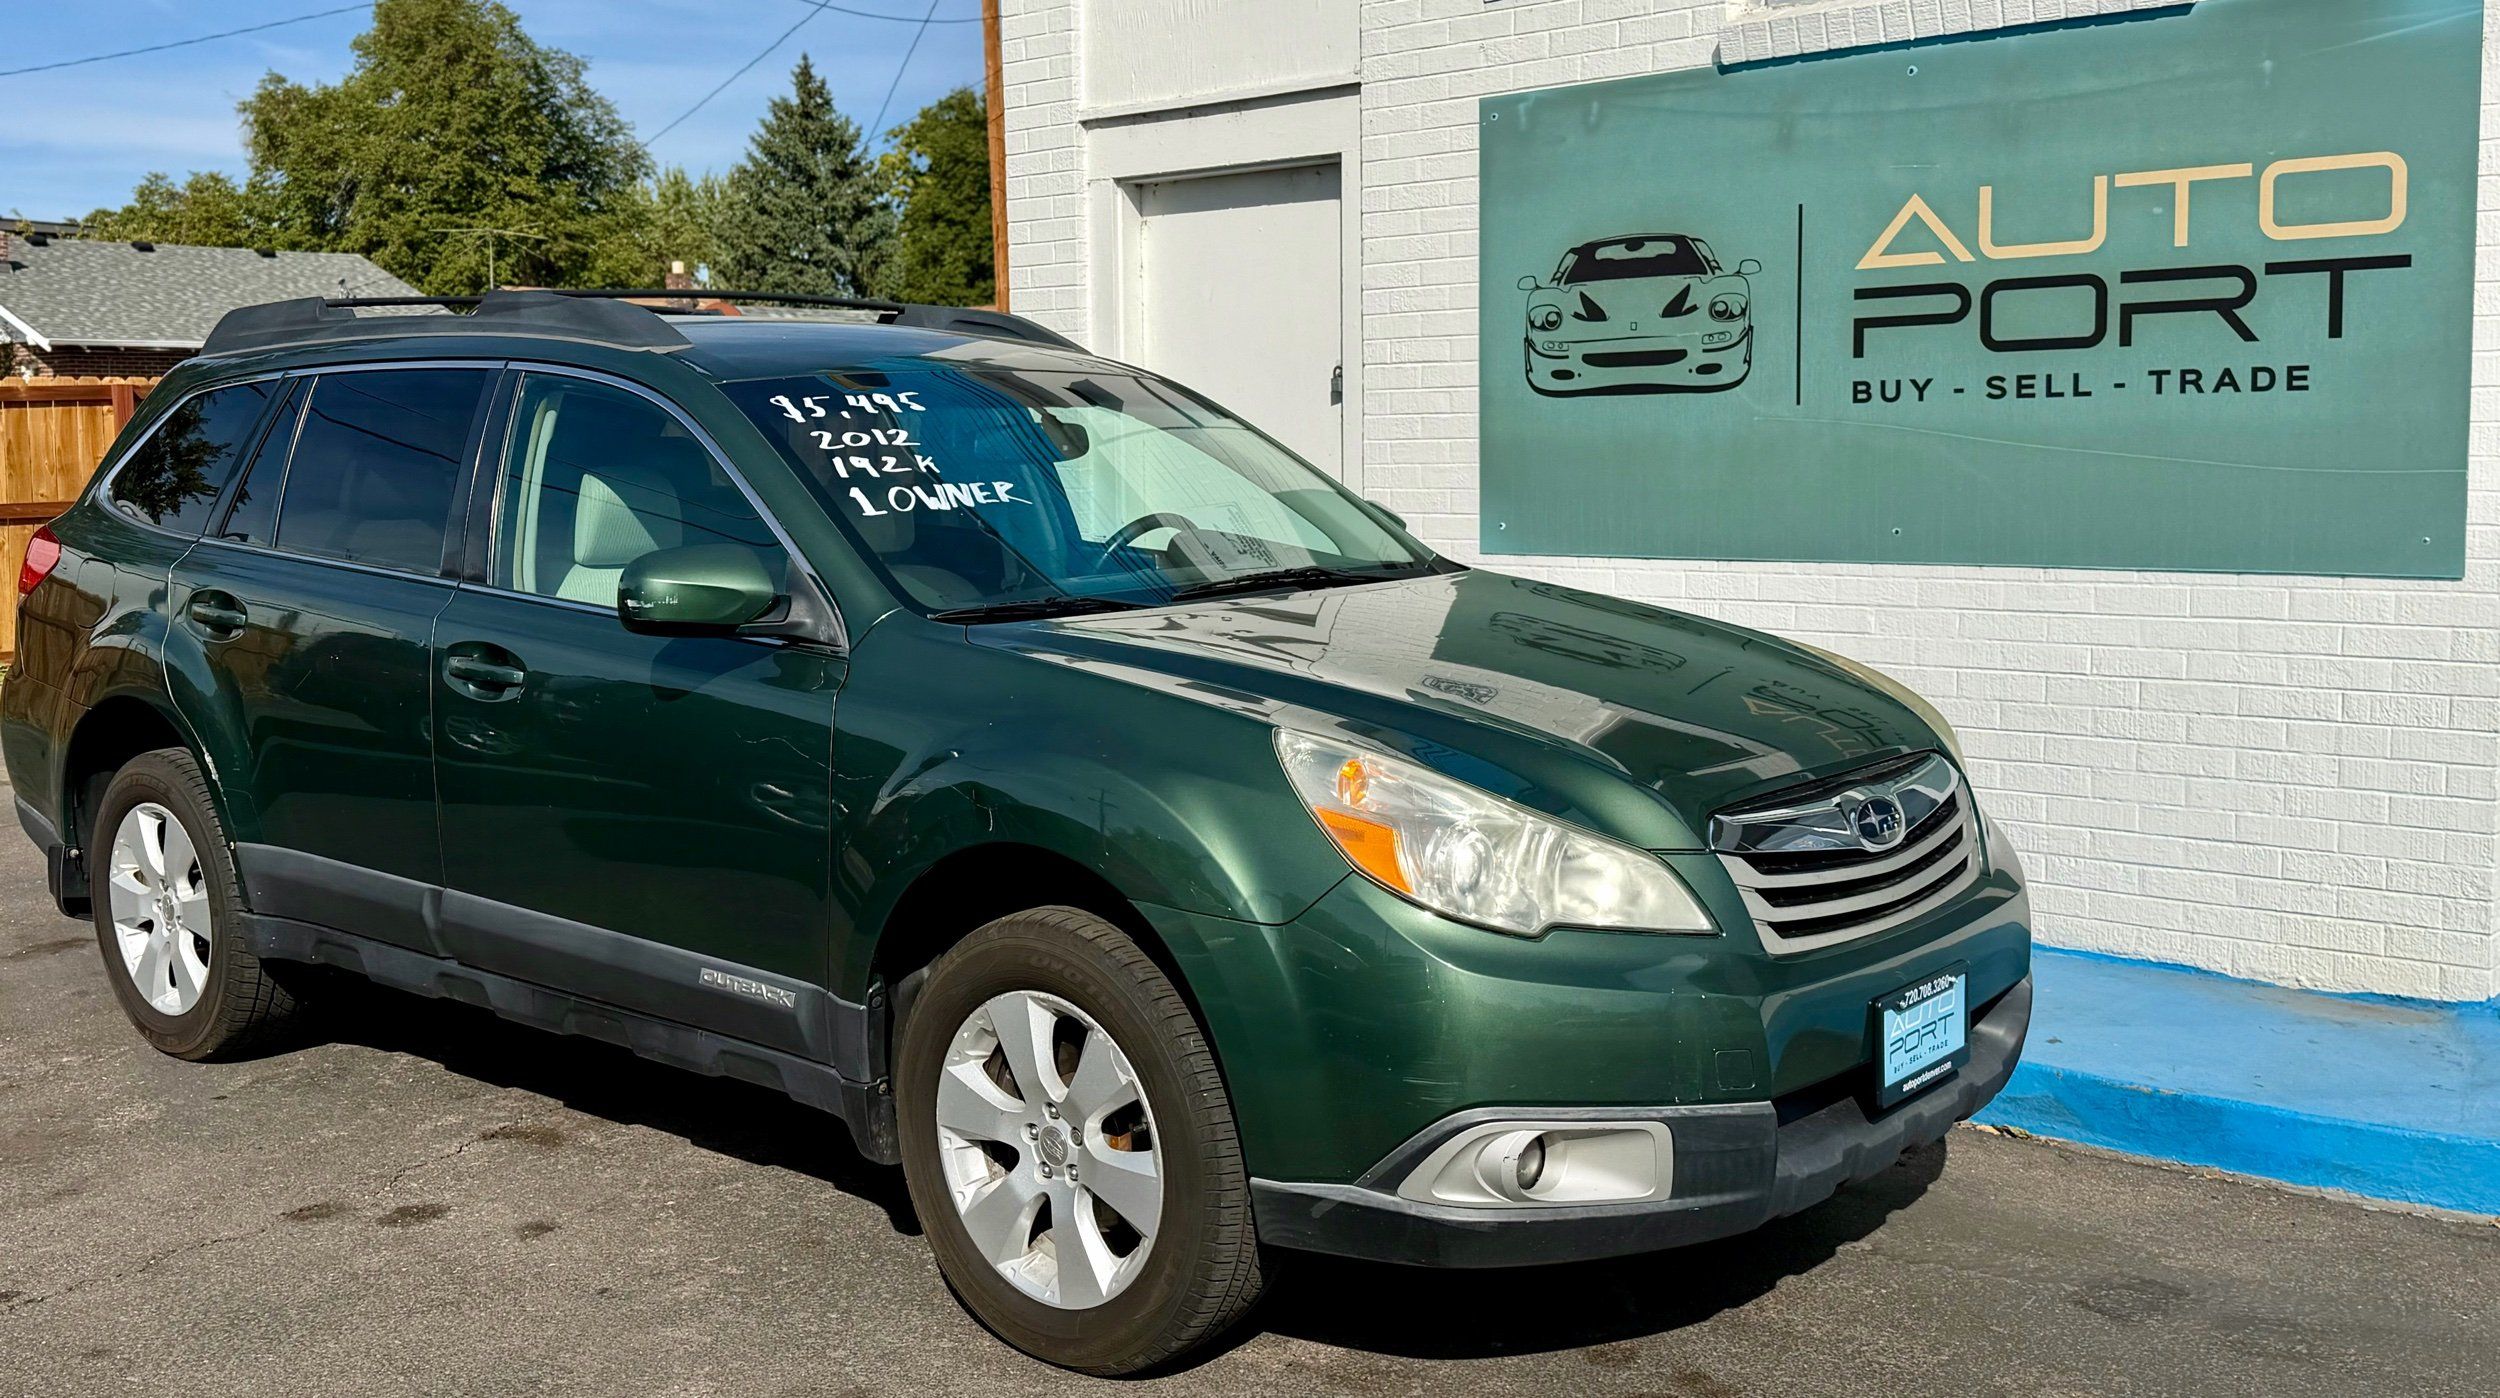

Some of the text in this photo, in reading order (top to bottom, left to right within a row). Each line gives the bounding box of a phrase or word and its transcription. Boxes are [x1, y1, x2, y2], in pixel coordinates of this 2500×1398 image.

[1855, 151, 2408, 269] AUTO
[1852, 253, 2412, 359] PORT
[1851, 377, 1934, 404] BUY
[1985, 372, 2092, 400] SELL
[2147, 364, 2311, 395] TRADE
[810, 428, 921, 450] 2012
[849, 481, 1033, 516] 1 OWNER
[703, 972, 794, 1008] OUTBACK
[1905, 974, 1950, 1007] 720.708.3260
[1890, 989, 1955, 1038] AUTO
[1889, 1012, 1955, 1064] PORT
[1909, 1053, 1922, 1064] SELL
[1928, 1039, 1948, 1053] TRADE
